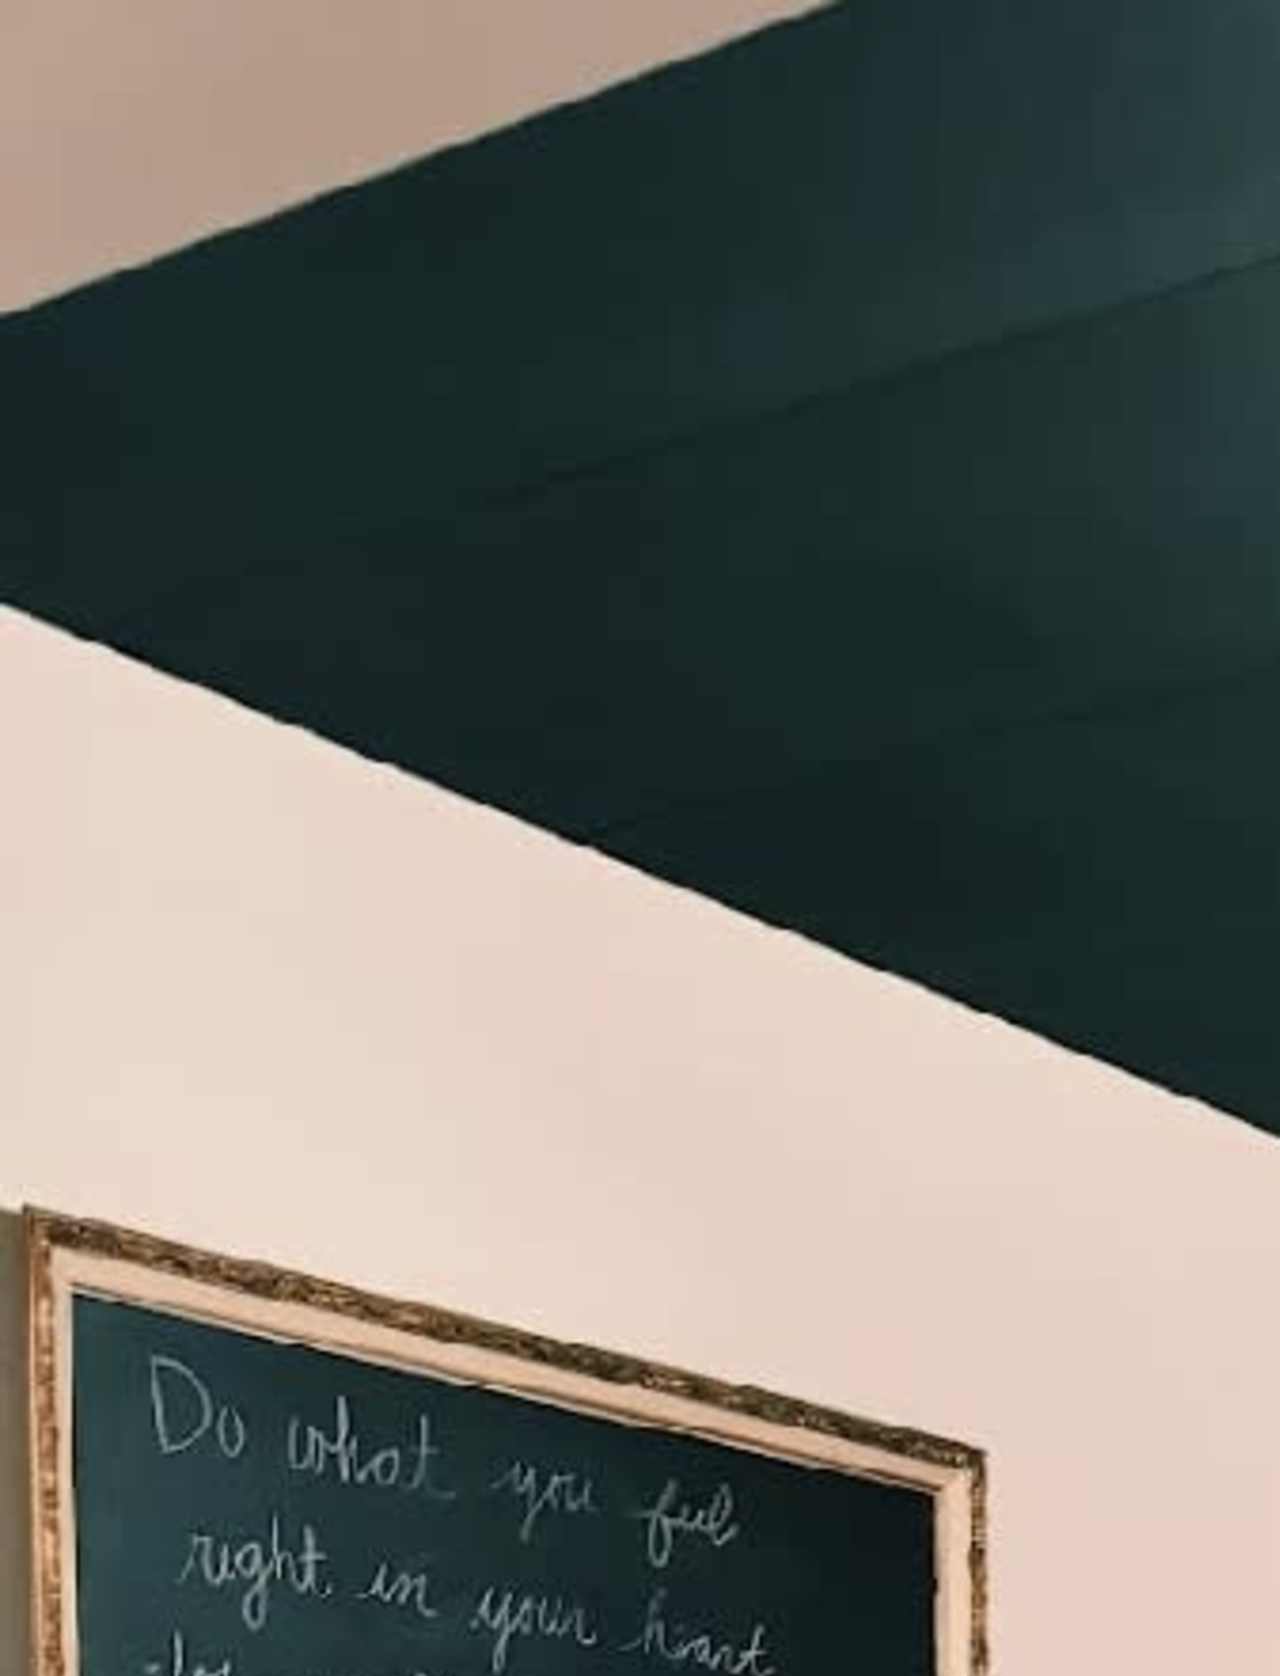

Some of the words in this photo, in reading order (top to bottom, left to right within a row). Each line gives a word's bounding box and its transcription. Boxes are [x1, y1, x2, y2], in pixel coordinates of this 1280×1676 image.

[151, 1356, 245, 1458] Do
[288, 1396, 456, 1499] what
[491, 1461, 598, 1543] you
[178, 1513, 333, 1630] right
[356, 1562, 440, 1617] in
